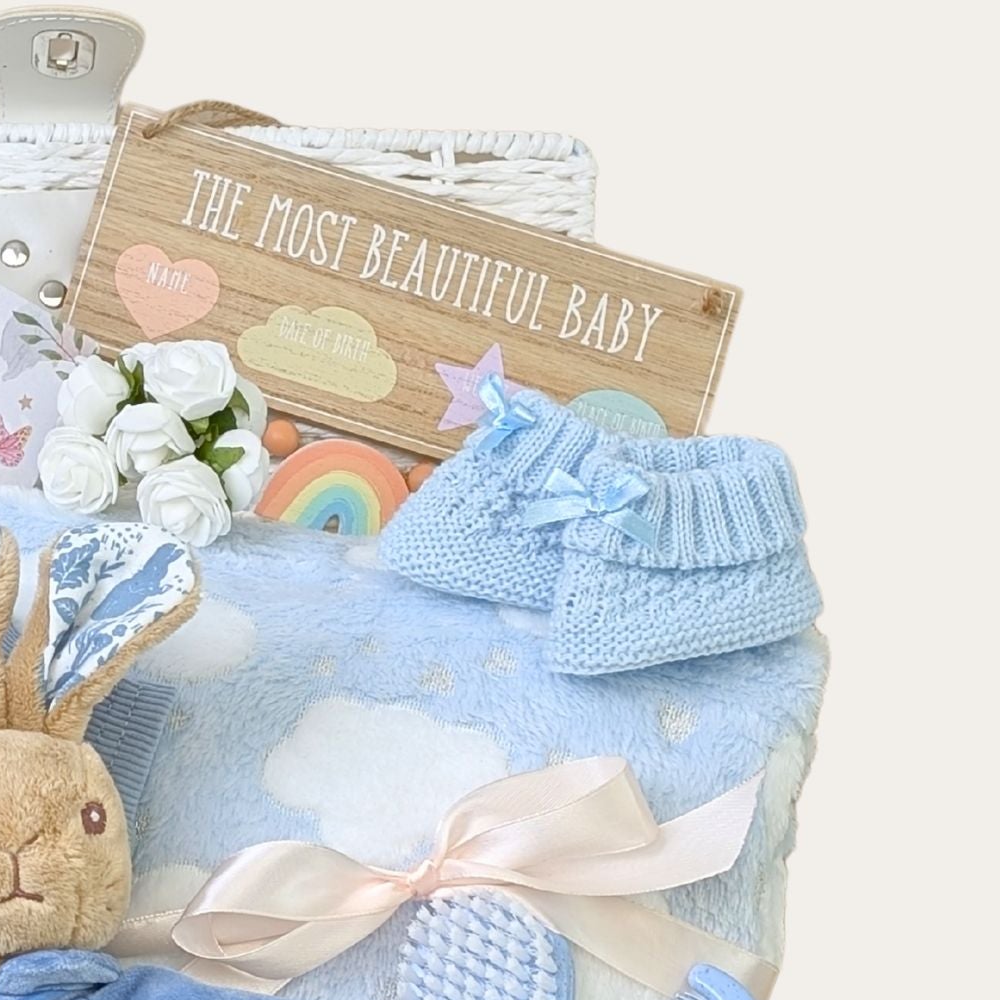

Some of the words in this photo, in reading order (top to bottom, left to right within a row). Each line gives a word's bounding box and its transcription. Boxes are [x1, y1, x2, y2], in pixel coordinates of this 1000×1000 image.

[146, 262, 192, 295] NAME
[181, 168, 252, 240] THE
[253, 193, 357, 271] MOST
[359, 223, 550, 331] BEAUTIFUL
[558, 283, 664, 362] BABY
[280, 315, 312, 346] DATE
[312, 327, 332, 351] OF
[331, 333, 372, 362] BIRTH
